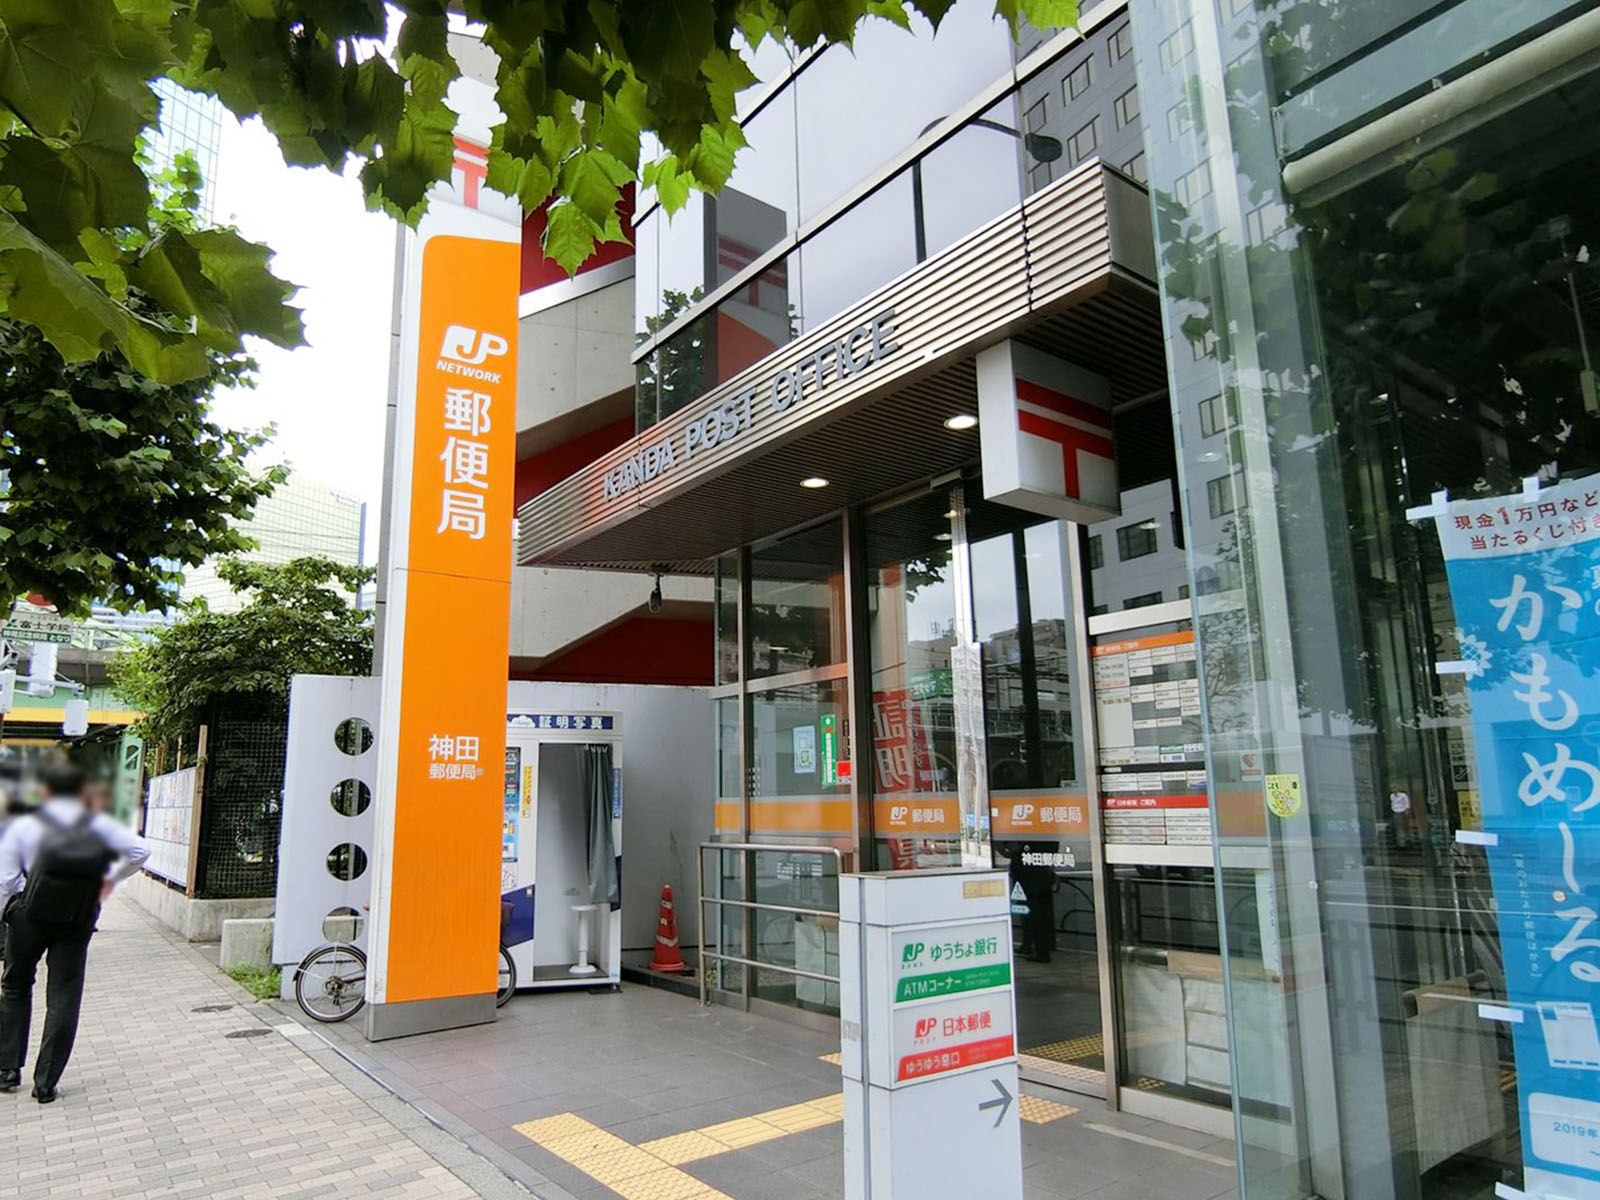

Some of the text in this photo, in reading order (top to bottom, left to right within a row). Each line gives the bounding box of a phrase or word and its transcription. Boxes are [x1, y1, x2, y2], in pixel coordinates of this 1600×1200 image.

[440, 325, 509, 365] JP
[436, 360, 501, 384] NETWORK
[603, 308, 900, 500] KANDA POST OFFICE
[437, 387, 492, 540] 郵便局
[1454, 490, 1599, 530] 現金1万円など
[539, 715, 603, 729] 証明写真
[428, 734, 480, 761] 神田
[429, 763, 477, 780] 郵便局
[890, 806, 908, 820] JP
[1012, 804, 1082, 823] JP 郵便局
[1021, 852, 1076, 867] 神田郵便局
[902, 937, 997, 962] JP ゆうちょ銀行
[904, 976, 961, 996] ATMコーナー
[915, 1010, 992, 1038] JP 日本郵便
[905, 1051, 961, 1075] ゆうゆう窓口
[1553, 1121, 1599, 1138] 2019年
